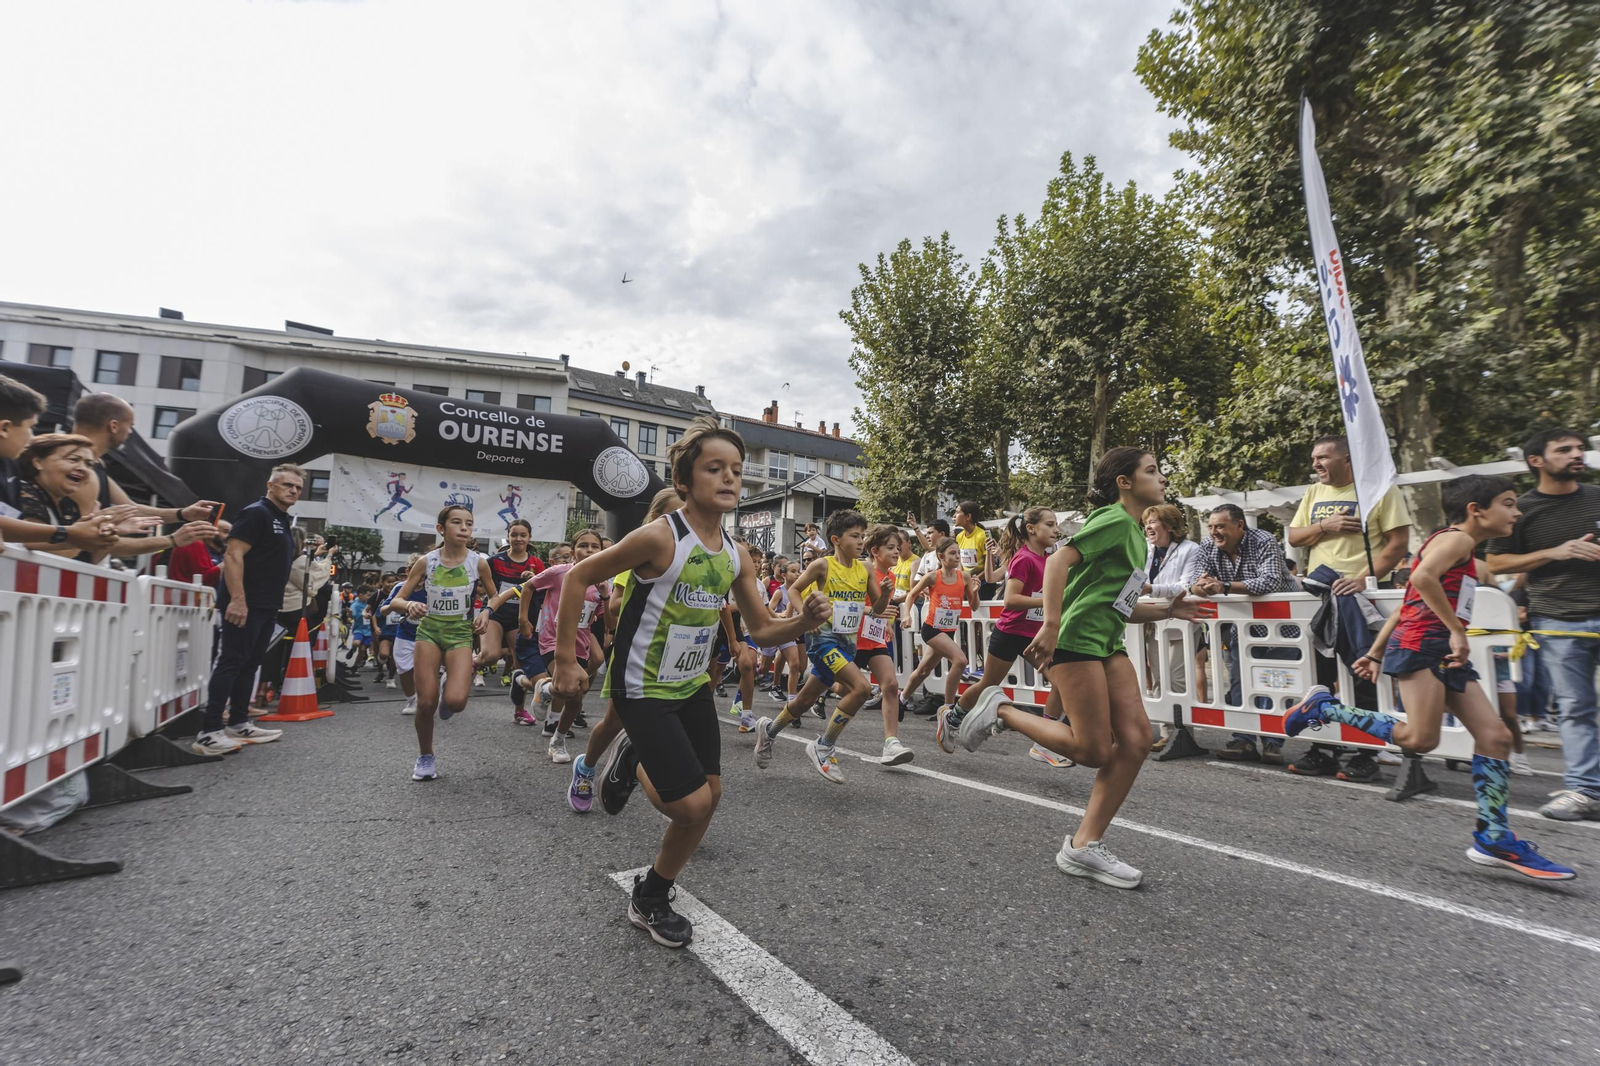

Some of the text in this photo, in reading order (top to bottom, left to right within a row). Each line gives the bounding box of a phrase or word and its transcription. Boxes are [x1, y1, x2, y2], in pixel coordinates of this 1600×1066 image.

[225, 399, 307, 450] CONSELLO MUNICIPAL DE DEPORTES
[439, 401, 546, 428] Concello de
[438, 419, 564, 454] OURENSE
[241, 443, 280, 456] OURENSE
[476, 450, 525, 465] Deportes
[597, 458, 609, 487] CONSELLO
[604, 449, 630, 459] MUNICIPAL
[432, 599, 459, 611] 4206
[1124, 589, 1139, 610] 40
[840, 615, 860, 629] 420
[674, 649, 707, 672] 4014
